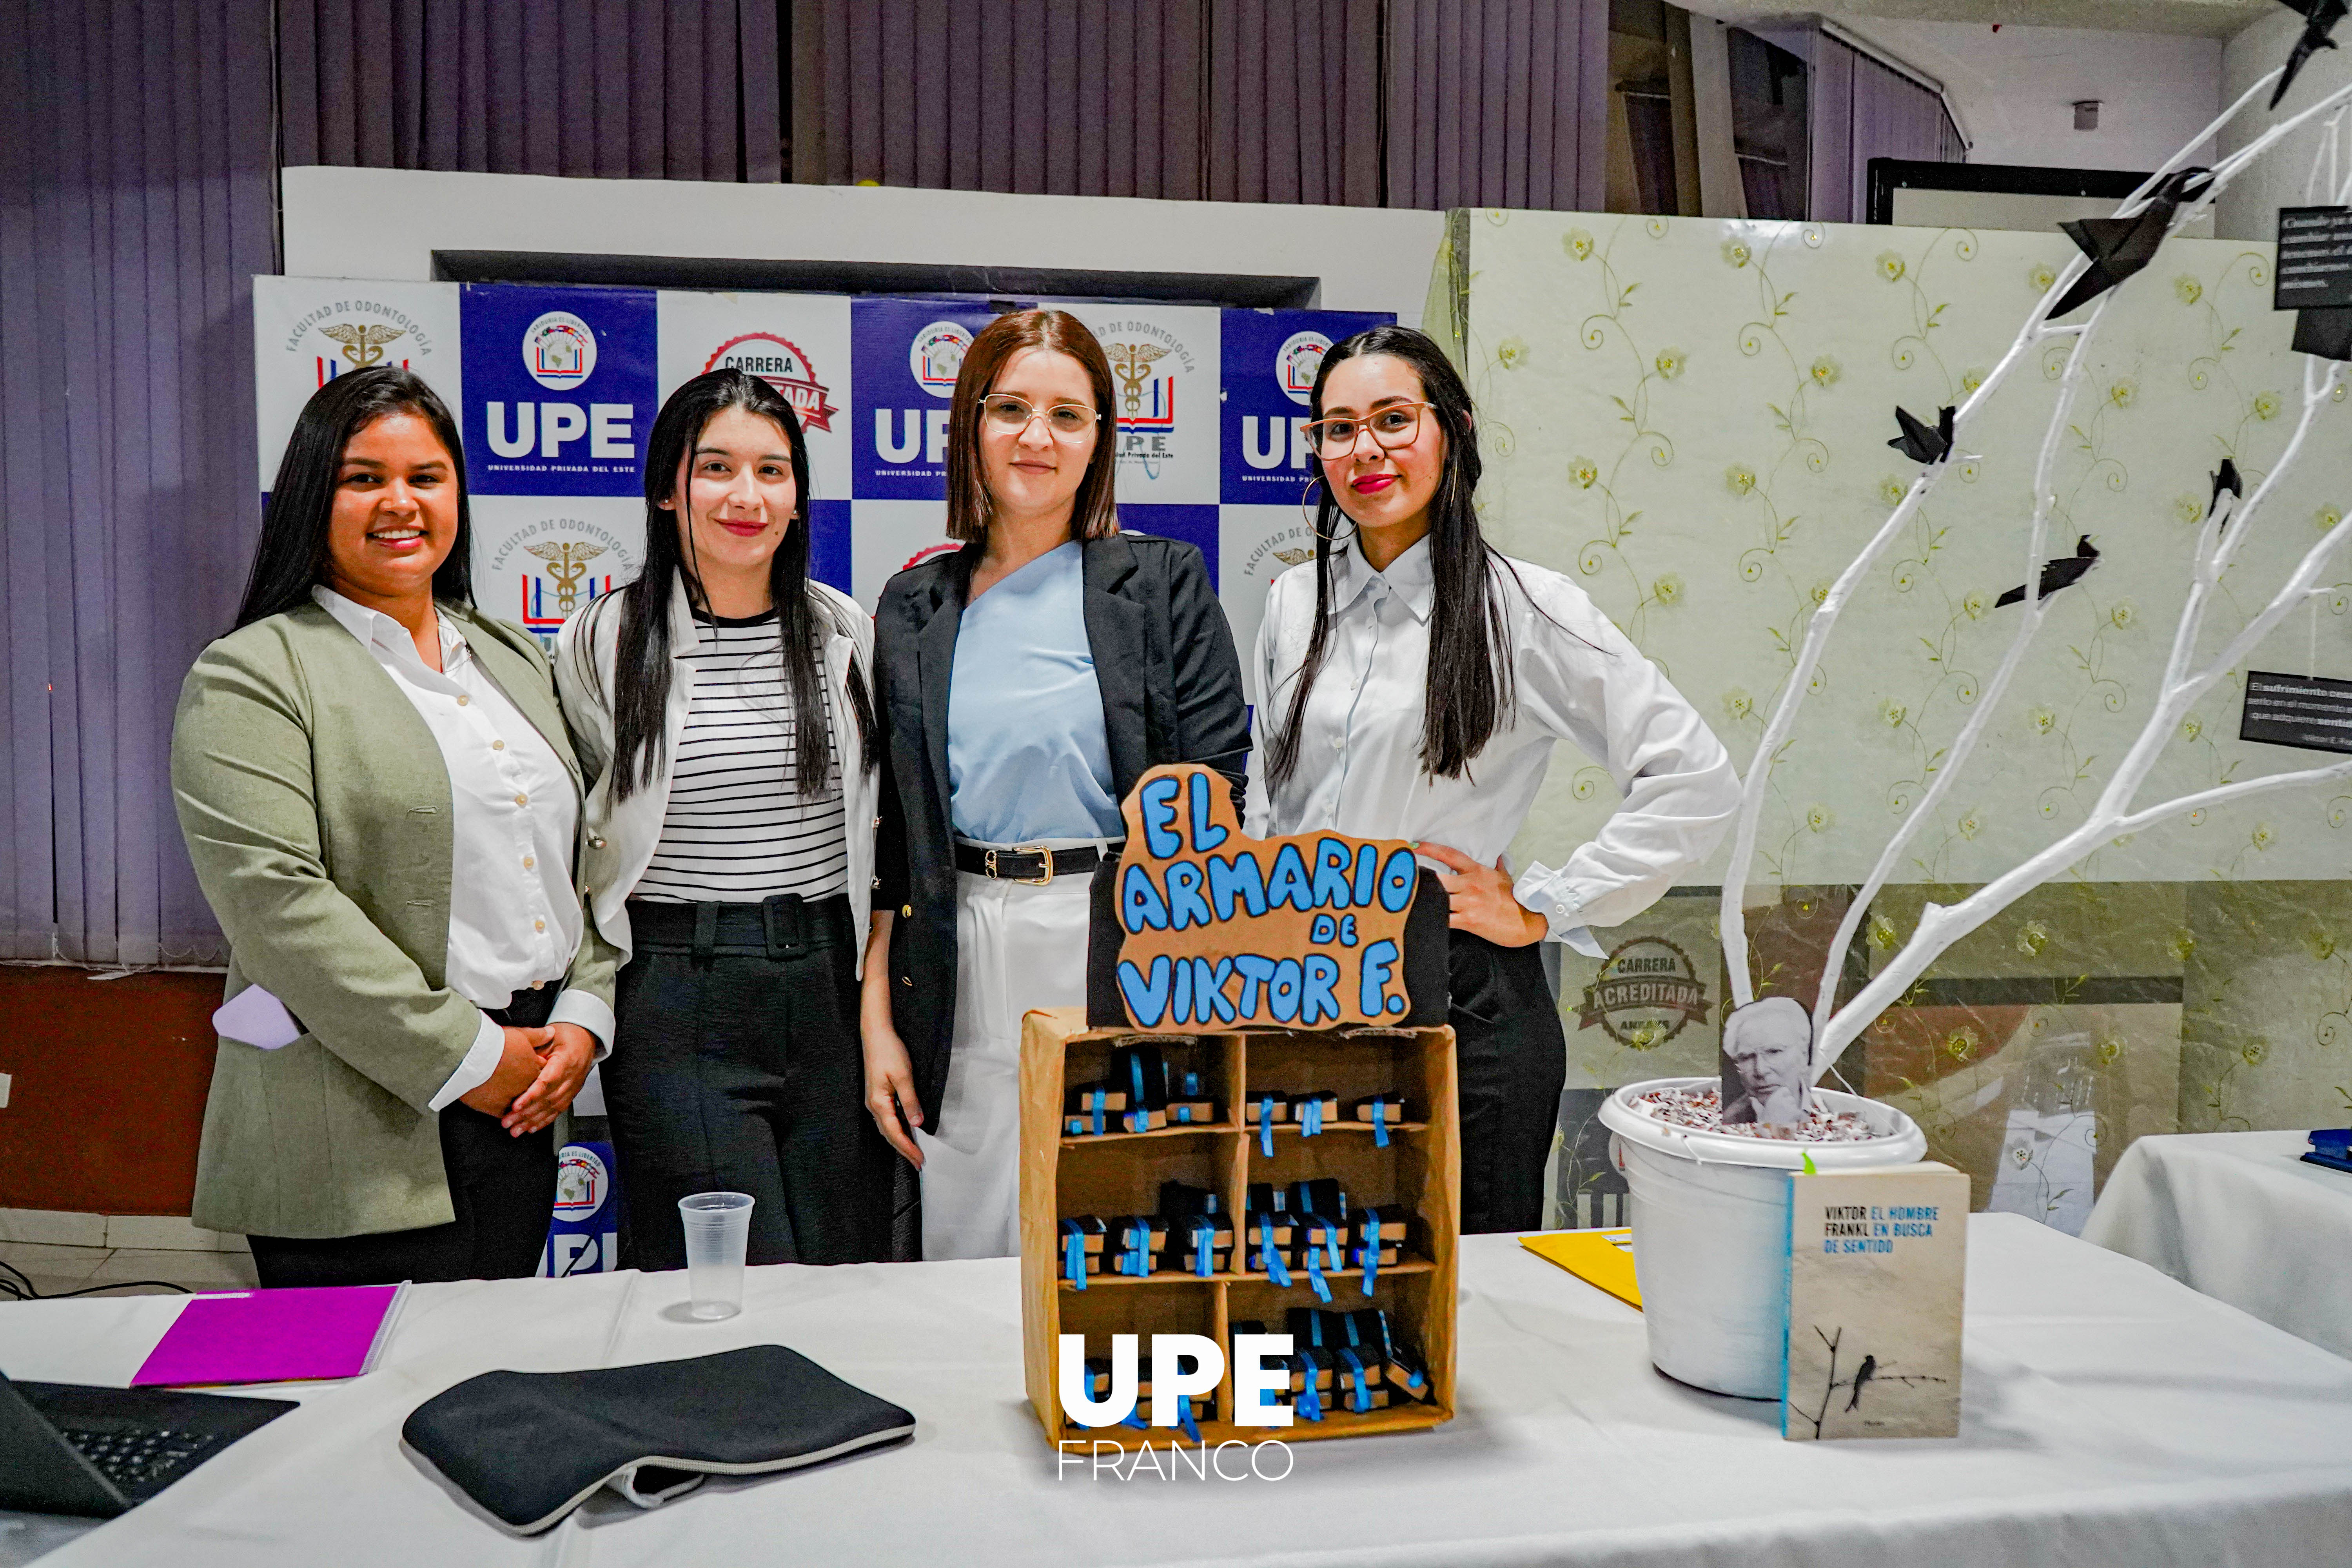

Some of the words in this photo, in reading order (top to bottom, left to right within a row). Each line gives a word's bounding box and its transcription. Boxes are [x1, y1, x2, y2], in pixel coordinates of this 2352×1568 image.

[286, 306, 332, 352] FACULTAD
[336, 301, 350, 312] DE
[355, 300, 432, 356] ODONTOLOGÍA
[1109, 321, 1123, 333] DE
[725, 356, 793, 372] CARRERA
[487, 401, 635, 458] UPE
[875, 408, 951, 463] UP
[1242, 416, 1314, 469] UP
[492, 525, 537, 570] FACULTAD
[541, 519, 555, 530] DE
[1244, 532, 1285, 575] FACULTAD
[1289, 527, 1302, 538] DE
[1140, 772, 1230, 859] EL
[1122, 838, 1418, 934] ARMARIO
[1310, 913, 1359, 947] DE
[1118, 953, 1341, 1026] VIKTOR
[1360, 938, 1407, 1018] F.
[1618, 957, 1676, 973] CARRERA
[1594, 983, 1698, 1009] ACREDITADA
[1825, 1206, 1867, 1220] VIKTOR
[1825, 1223, 1869, 1236] FRANKL
[1871, 1206, 1884, 1220] EL
[1889, 1206, 1939, 1221] HOMBRE
[1873, 1223, 1889, 1236] EN
[1894, 1223, 1933, 1237] BUSCA
[1825, 1240, 1838, 1253] DE
[1843, 1240, 1893, 1253] SENTIDO
